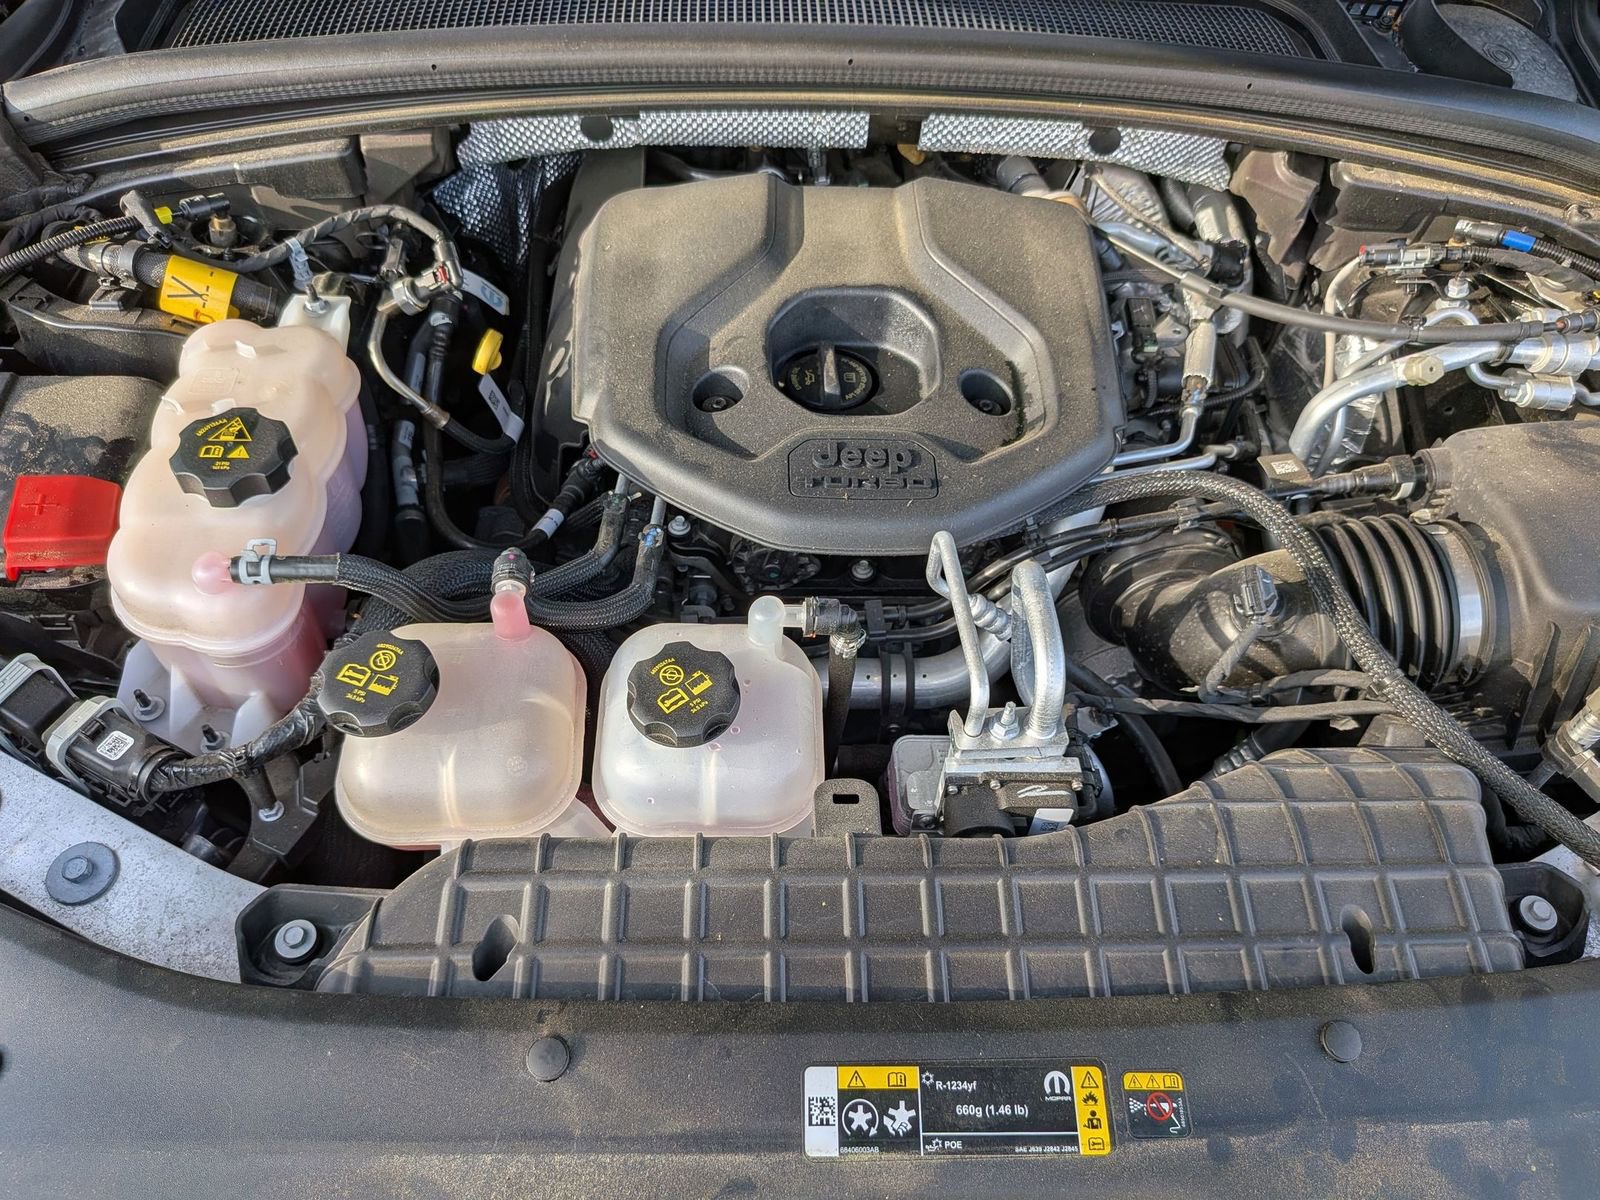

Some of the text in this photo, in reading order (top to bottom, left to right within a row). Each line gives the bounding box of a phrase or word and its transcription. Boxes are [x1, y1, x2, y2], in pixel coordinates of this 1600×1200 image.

[812, 442, 914, 474] Jeep
[796, 475, 934, 490] TURBO
[935, 1080, 977, 1092] R-1234yf
[956, 1104, 1029, 1118] 660g (1.46 lb)
[944, 1141, 963, 1150] POE
[1014, 1145, 1027, 1153] SAE
